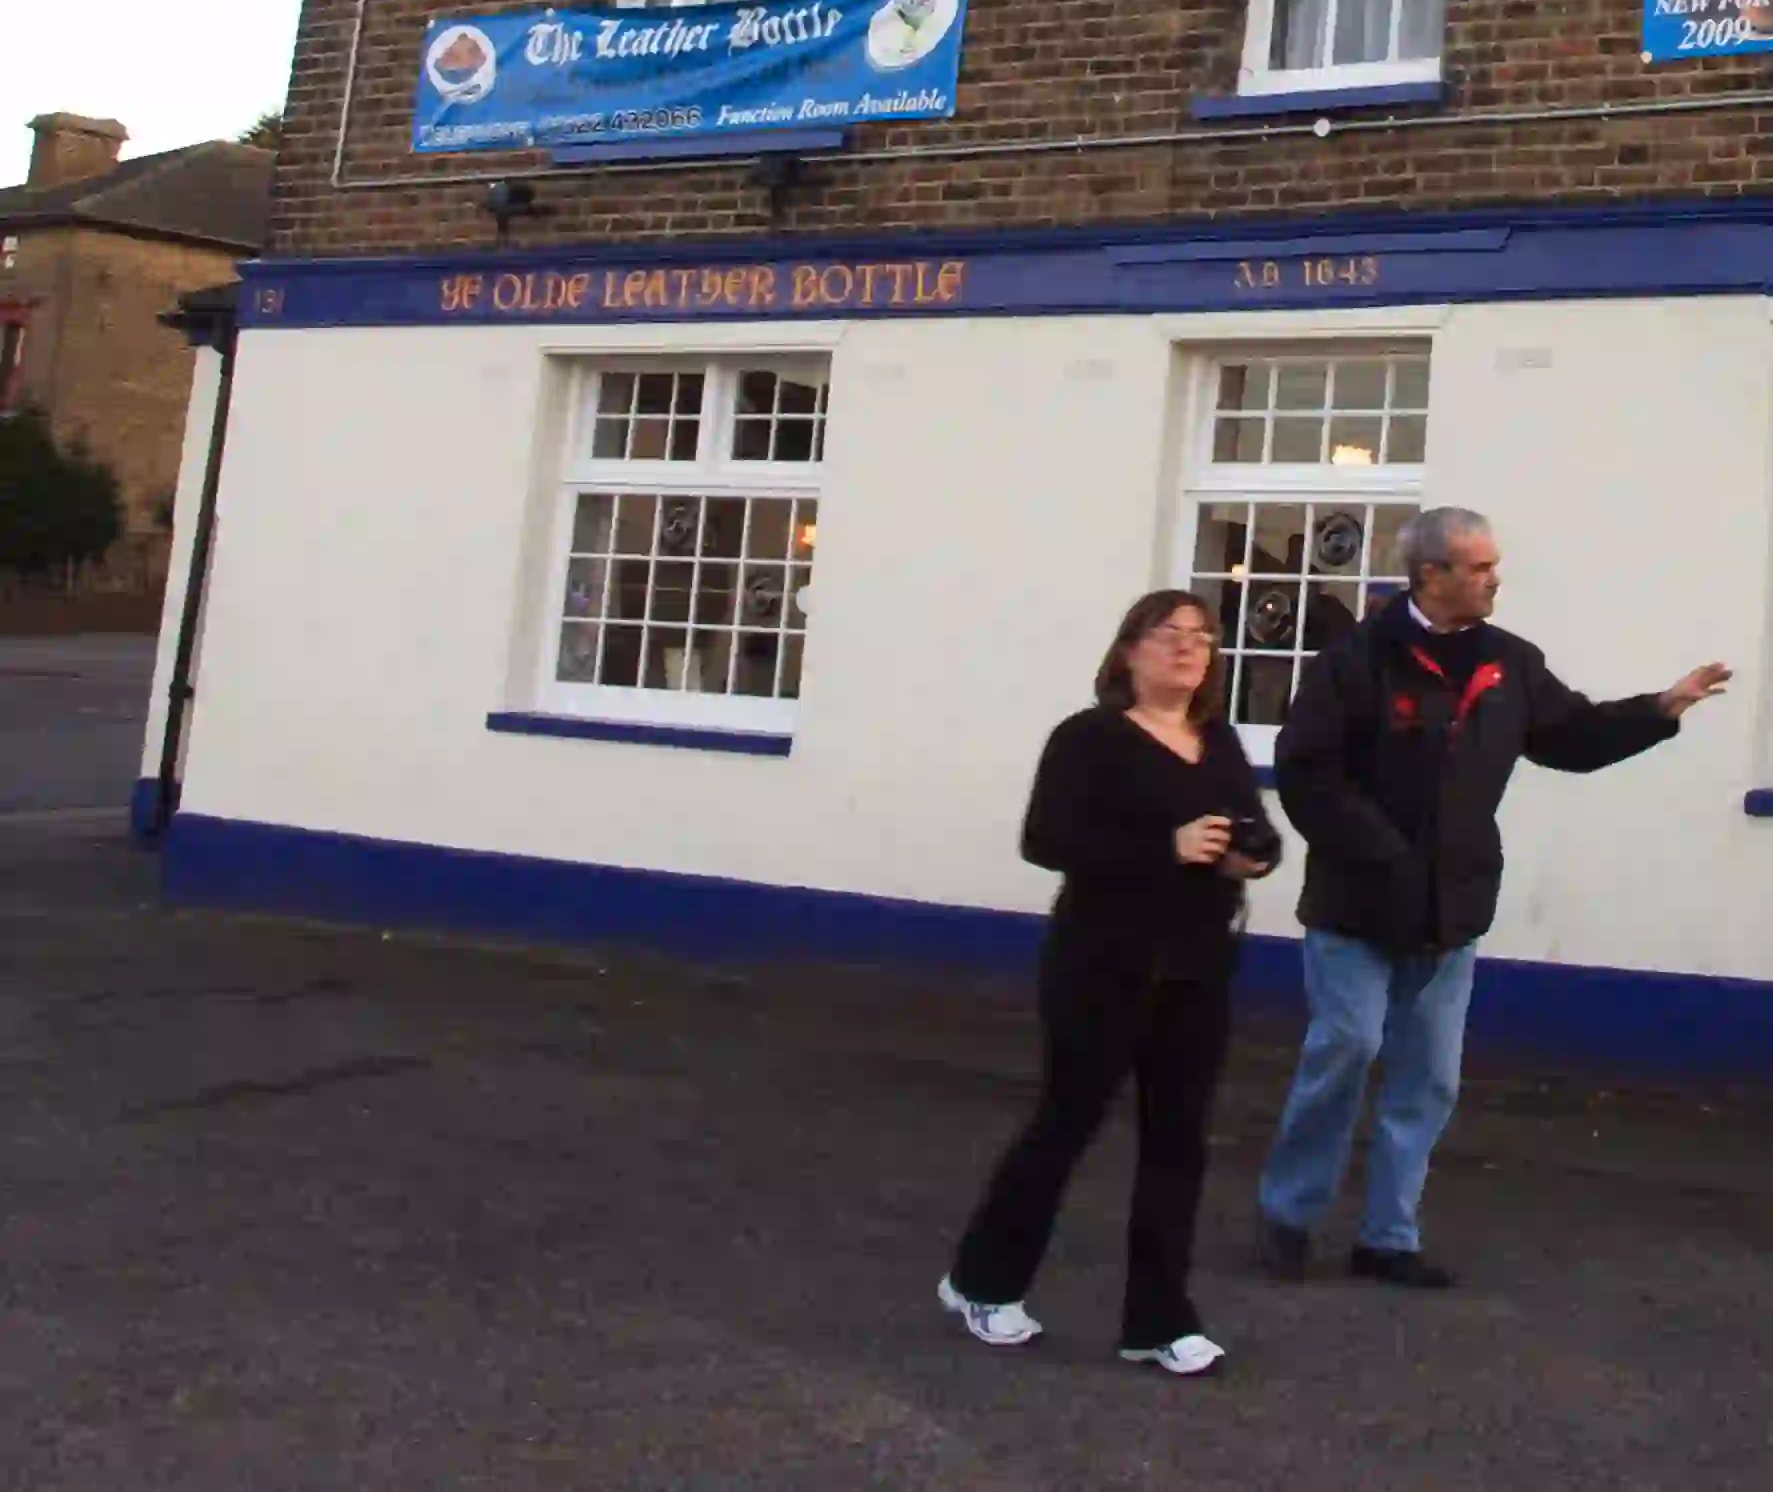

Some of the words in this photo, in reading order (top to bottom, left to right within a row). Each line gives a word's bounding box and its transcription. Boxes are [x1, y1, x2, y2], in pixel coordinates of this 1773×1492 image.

[525, 20, 583, 66] The
[595, 17, 720, 61] Leather
[1677, 15, 1752, 50] 2009
[715, 101, 794, 127] Function
[797, 98, 849, 121] Room
[852, 87, 948, 117] Available
[492, 271, 592, 311] OLDE
[602, 265, 779, 309] LEATHER
[791, 260, 966, 307] BOTTLE
